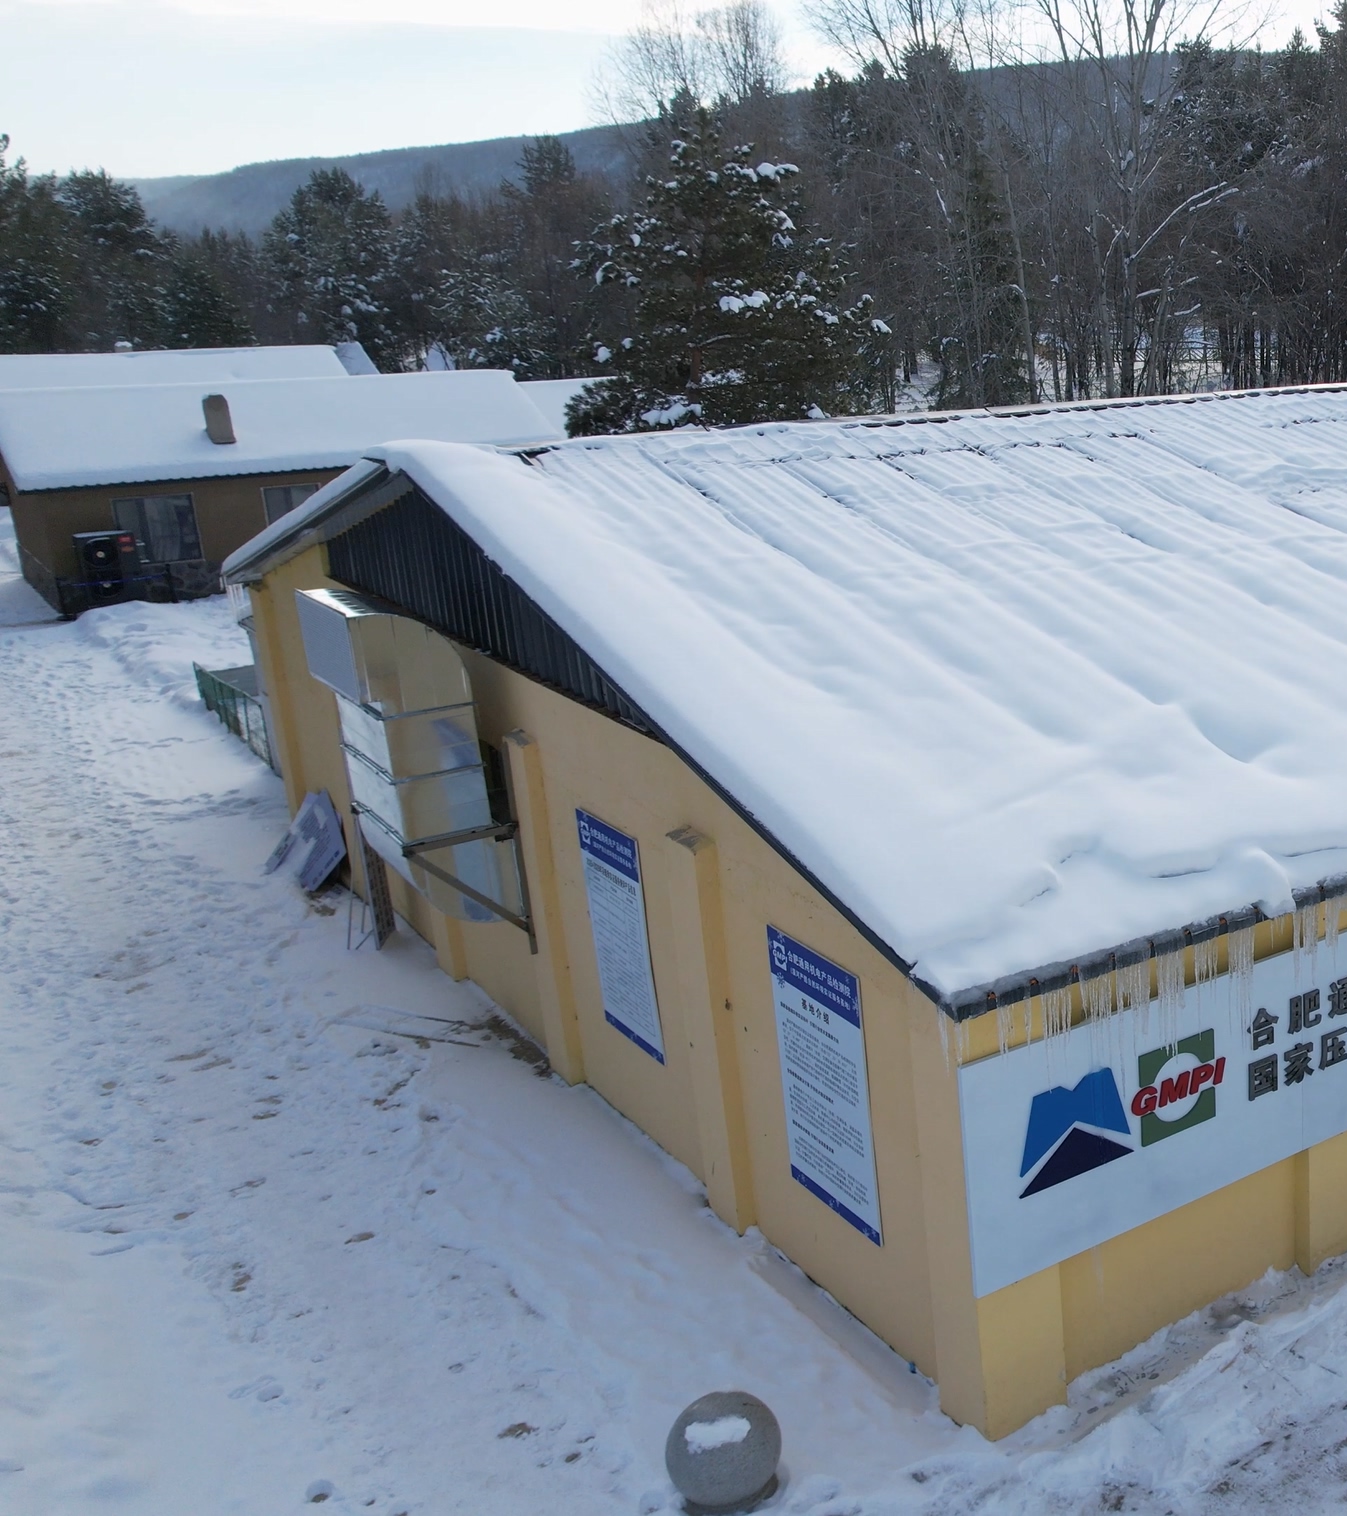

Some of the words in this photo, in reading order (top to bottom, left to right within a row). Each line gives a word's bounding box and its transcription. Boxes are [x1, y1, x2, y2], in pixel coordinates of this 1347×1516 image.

[801, 998, 829, 1025] 基地介绍
[1130, 1056, 1226, 1117] GMPI
